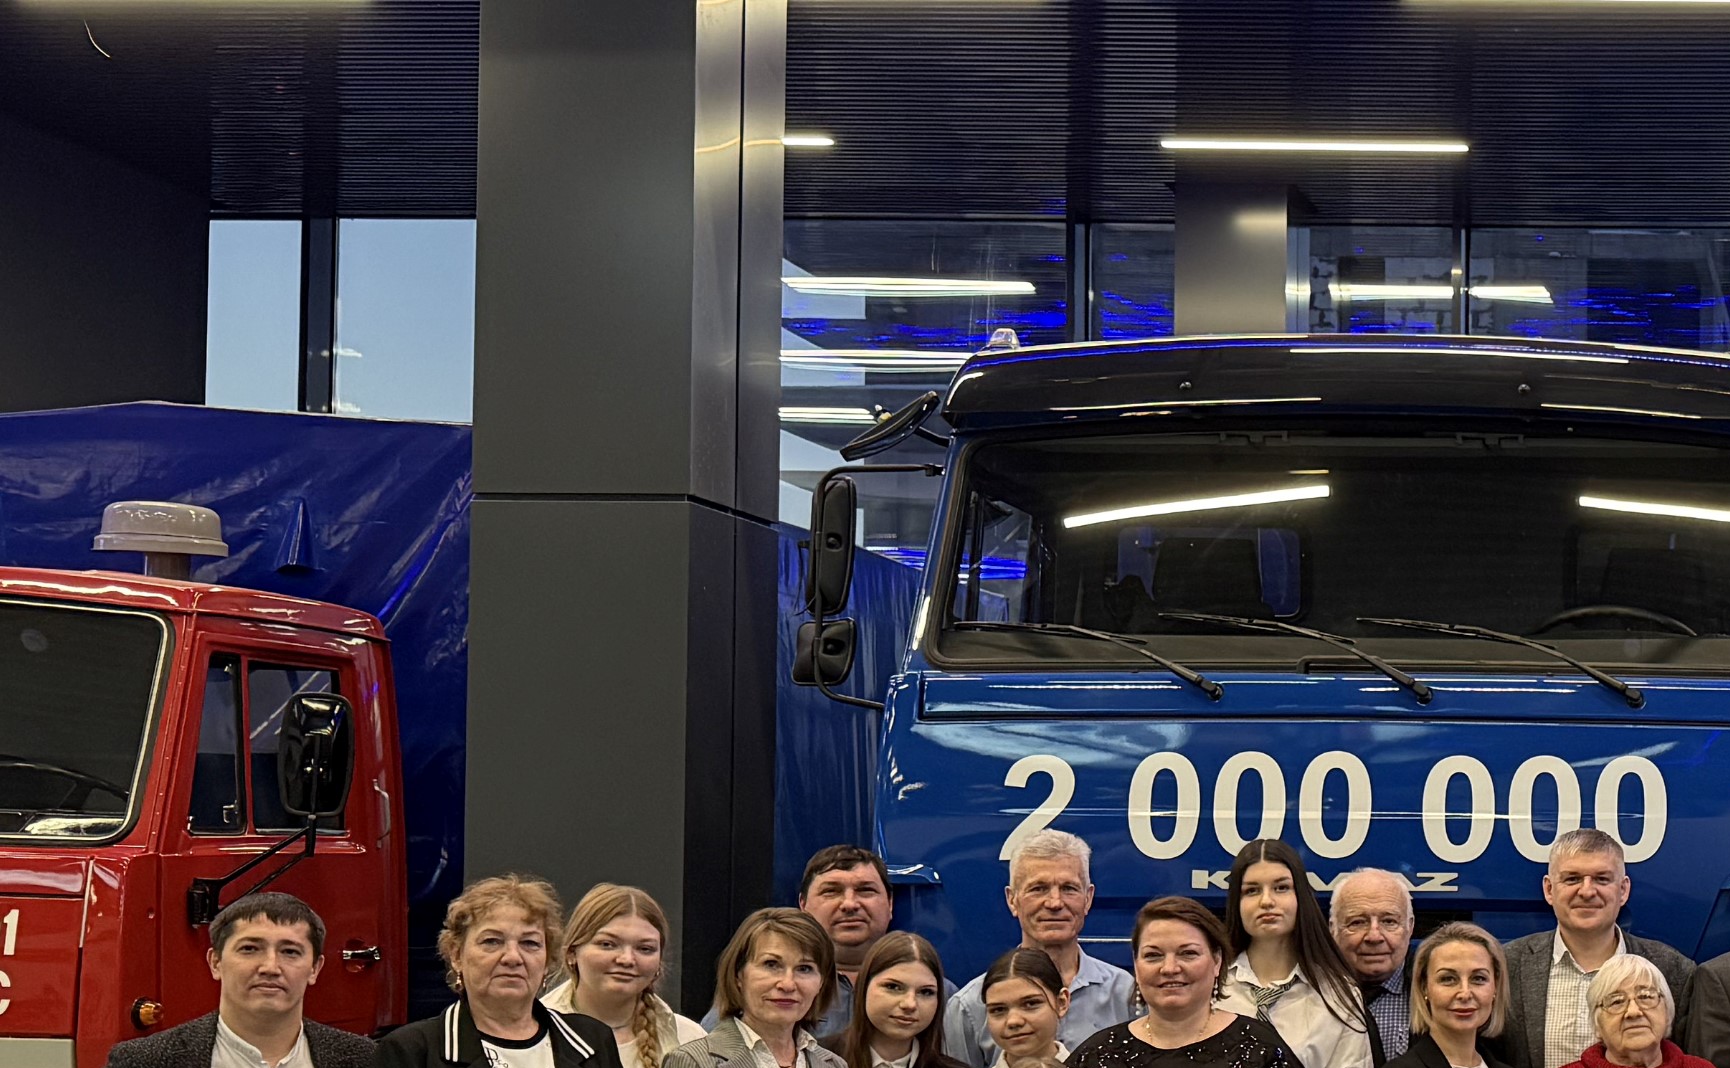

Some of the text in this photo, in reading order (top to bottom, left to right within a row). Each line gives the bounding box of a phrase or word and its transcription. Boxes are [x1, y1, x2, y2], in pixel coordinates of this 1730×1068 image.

[999, 751, 1668, 863] 2 000 000
